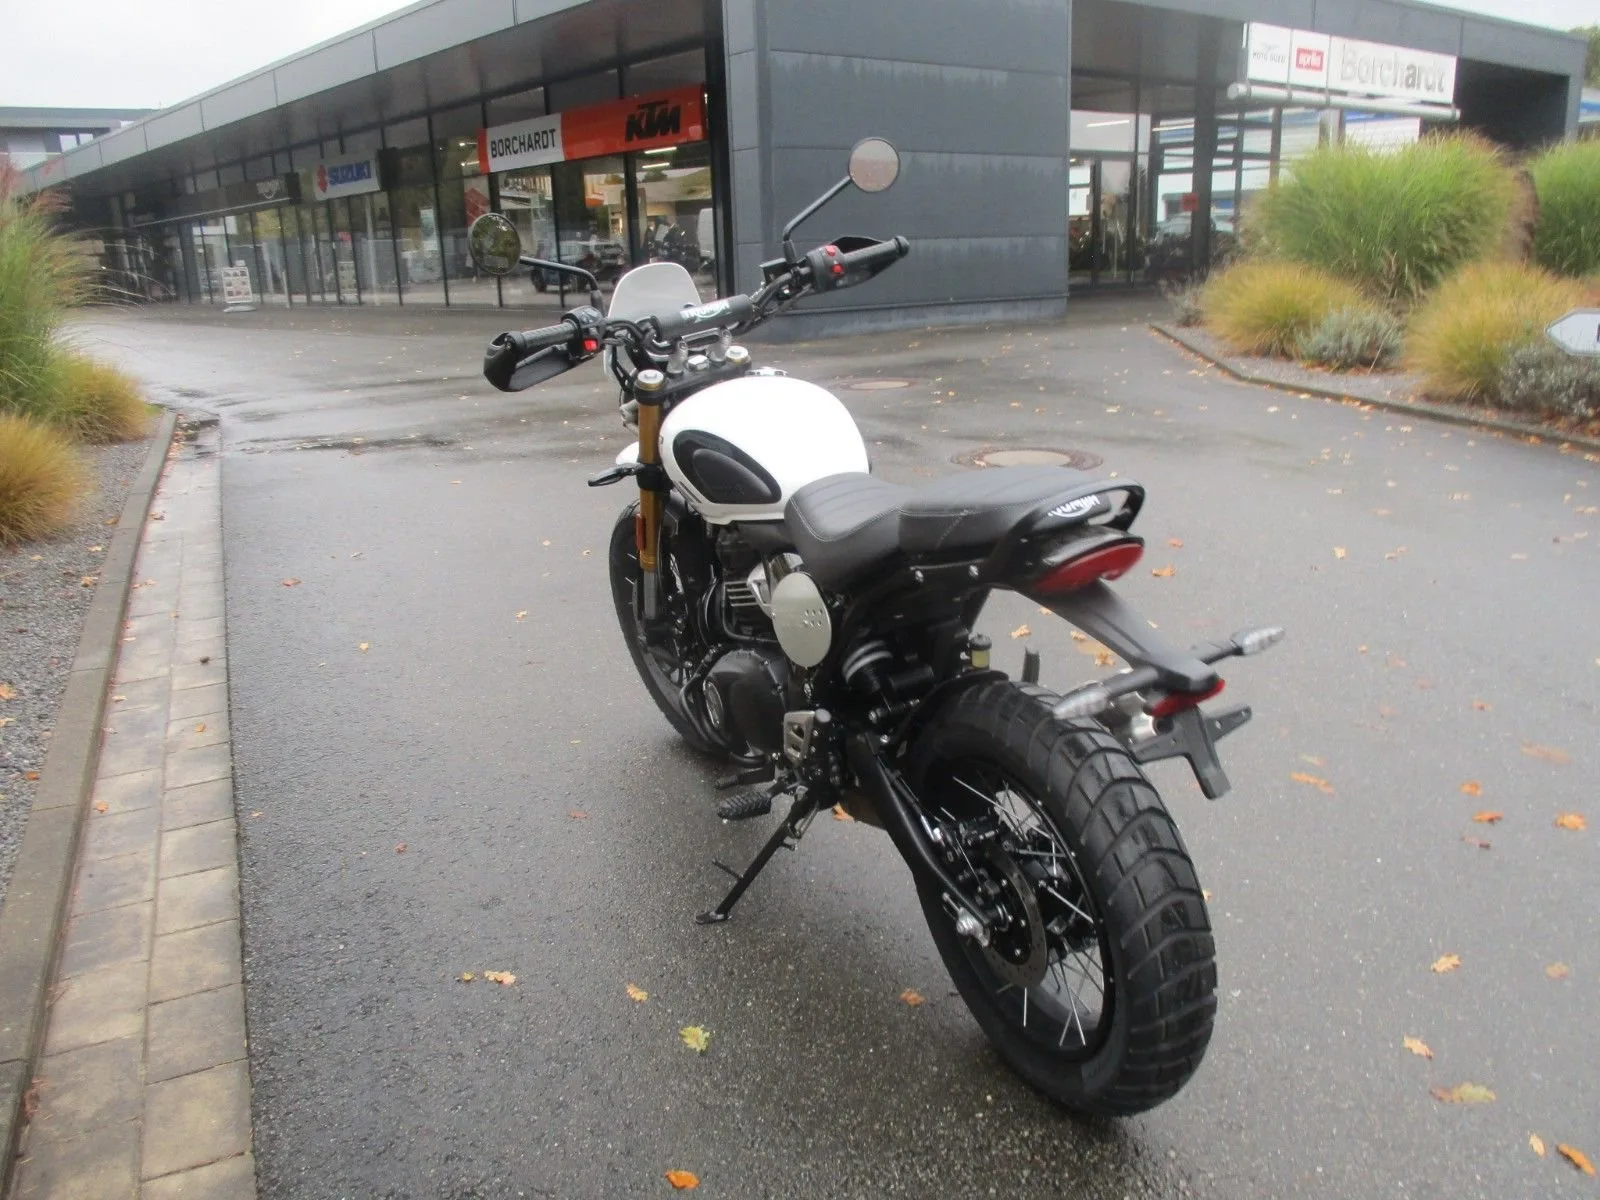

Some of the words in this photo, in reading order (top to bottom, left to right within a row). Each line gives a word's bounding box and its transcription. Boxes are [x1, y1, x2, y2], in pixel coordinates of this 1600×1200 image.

[1340, 43, 1445, 93] Borchardt
[625, 100, 681, 141] KTM
[491, 129, 556, 158] BORCHARDT
[328, 160, 372, 185] SUZUKI
